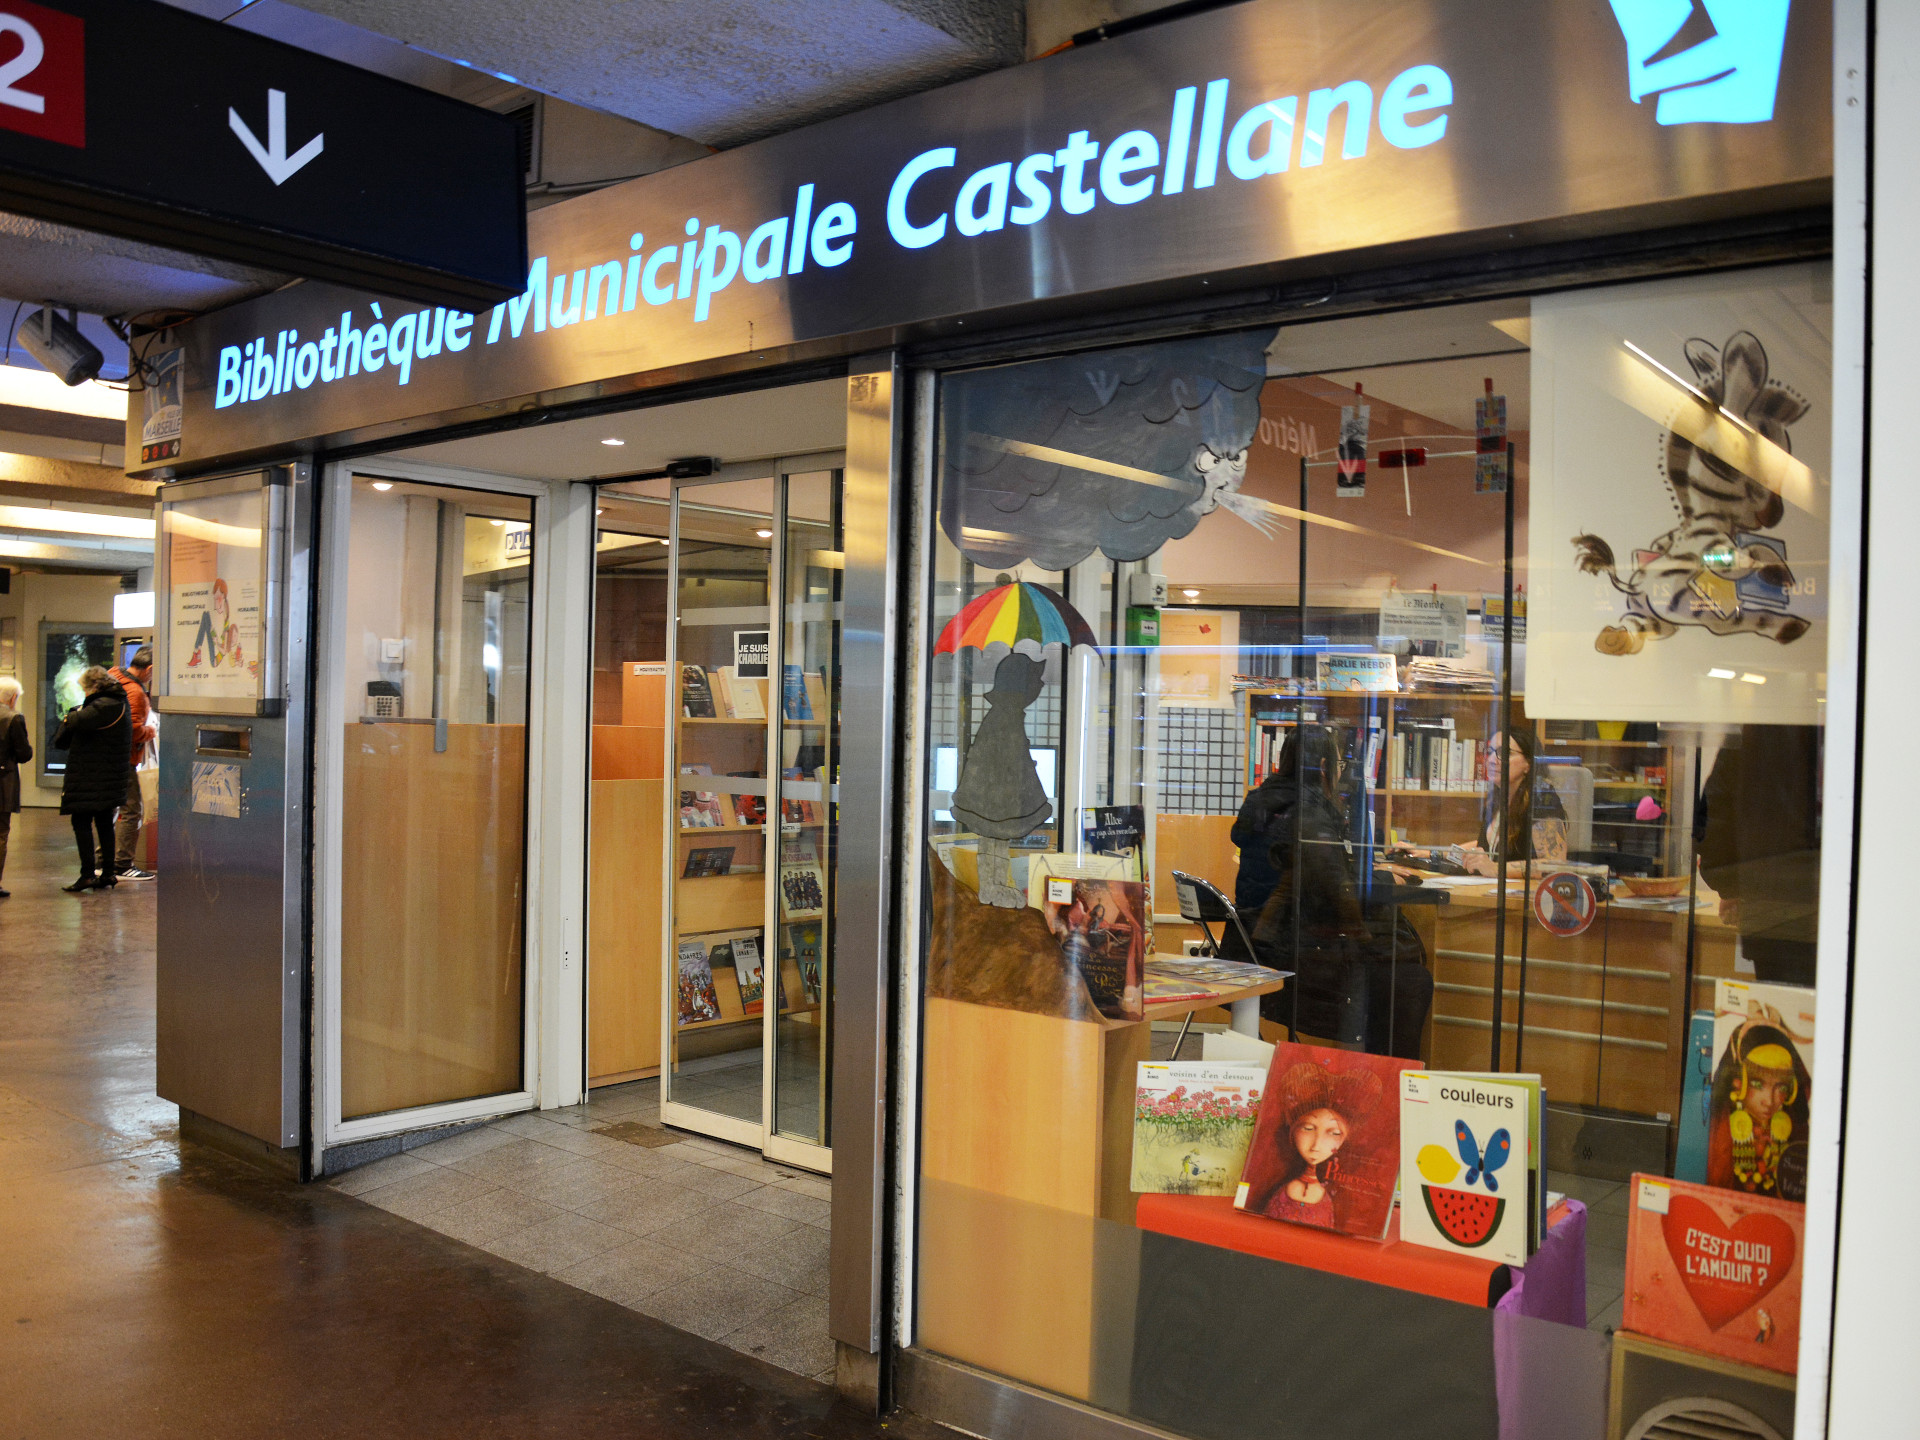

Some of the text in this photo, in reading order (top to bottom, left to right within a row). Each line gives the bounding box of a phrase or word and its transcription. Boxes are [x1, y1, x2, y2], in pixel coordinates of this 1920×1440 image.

[0, 13, 45, 114] 2
[215, 64, 1453, 410] Bibliothèque Municipale Castellane
[144, 417, 182, 437] MARSEILLE
[1414, 599, 1446, 610] Monde
[738, 643, 768, 653] JE SUIS
[738, 653, 768, 665] CHARLIE
[1360, 660, 1391, 669] HEBDO
[1104, 812, 1122, 826] Alice
[1169, 1070, 1197, 1078] voisins
[1201, 1069, 1219, 1080] d'en
[1222, 1071, 1255, 1081] dessous
[1440, 1087, 1514, 1109] couleurs
[1685, 1227, 1771, 1266] C'EST QUOI
[1686, 1254, 1752, 1285] L'AMOUR
[1757, 1267, 1768, 1287] ?
